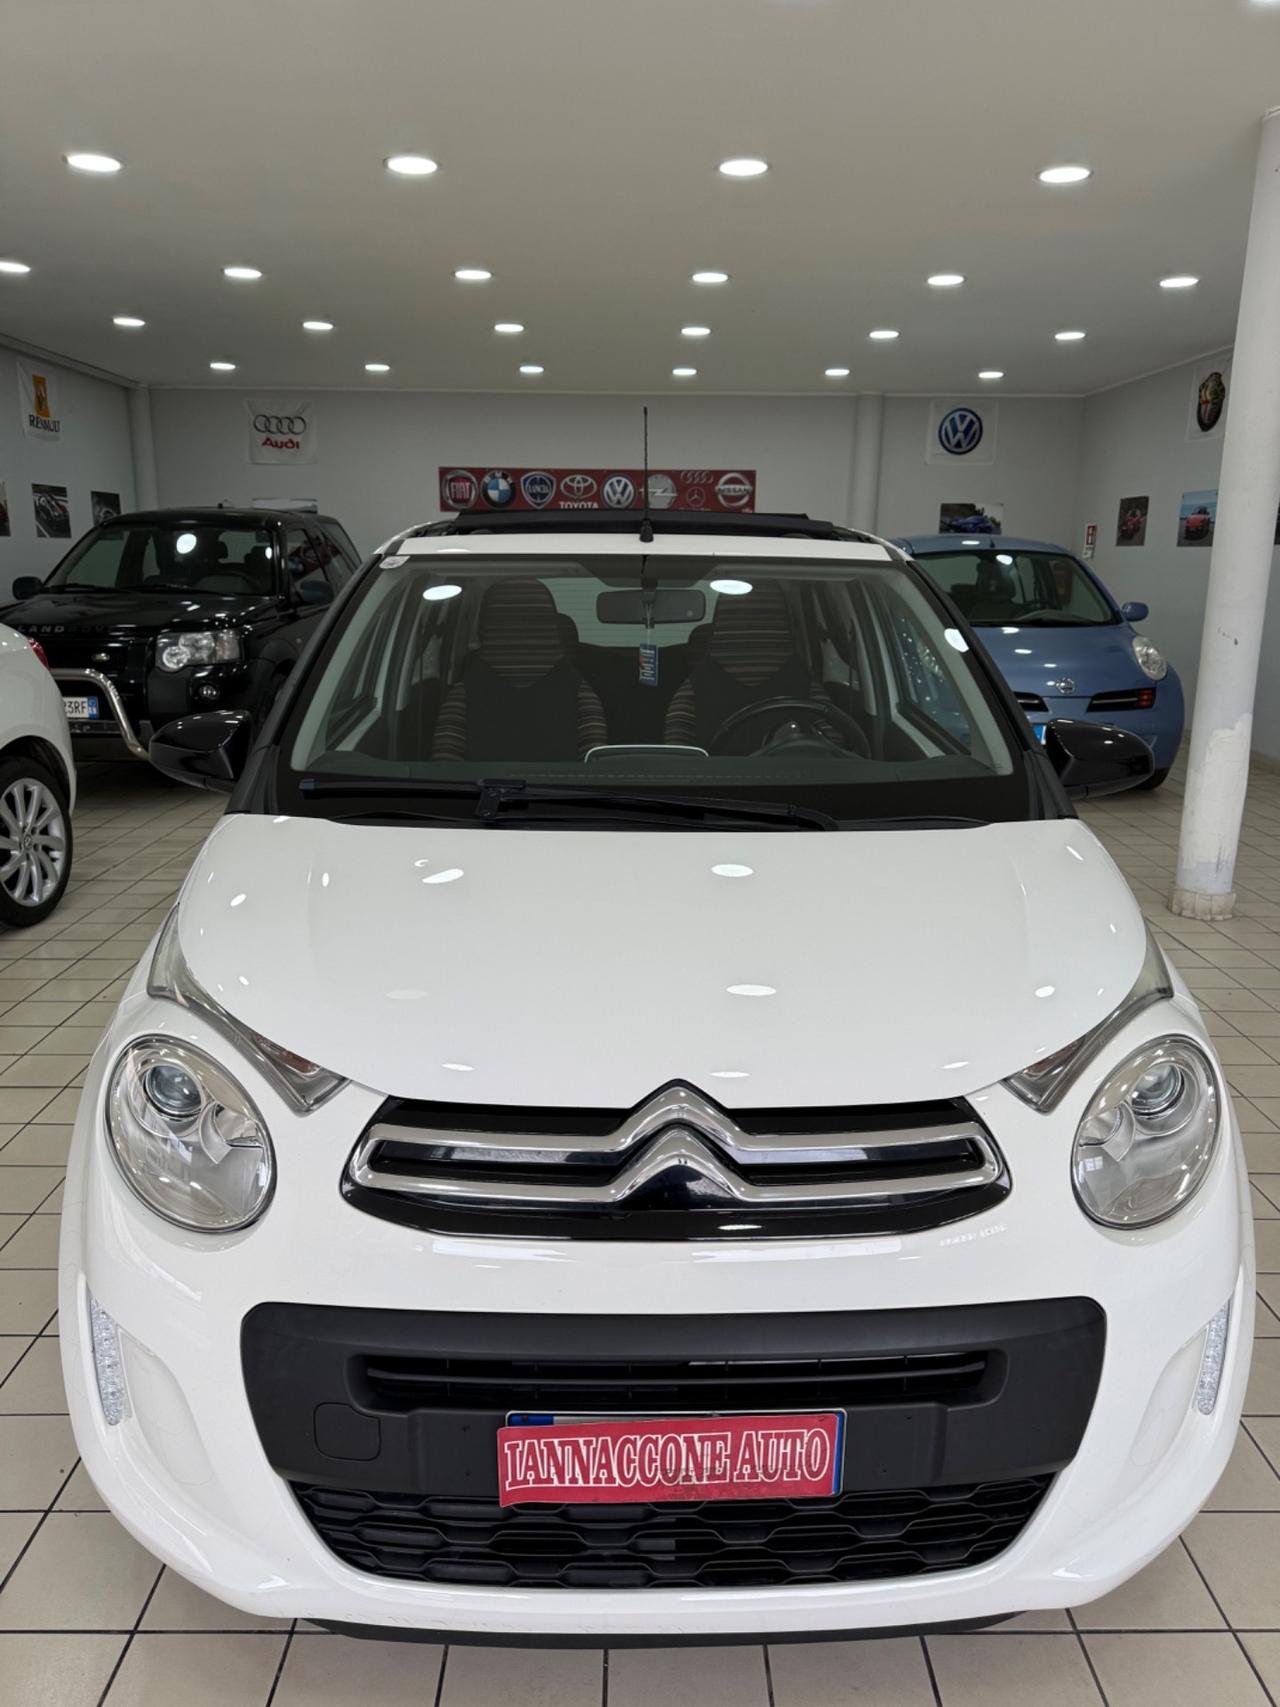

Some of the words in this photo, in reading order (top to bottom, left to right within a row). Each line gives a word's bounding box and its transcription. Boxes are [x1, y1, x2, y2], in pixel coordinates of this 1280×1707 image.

[262, 437, 300, 449] Audi
[450, 481, 471, 499] FIAT
[717, 487, 751, 495] NISSAN
[559, 501, 599, 509] TOYOTA
[17, 625, 65, 633] LAND
[504, 1432, 731, 1491] IANNACCONE
[733, 1428, 830, 1482] AUTO
